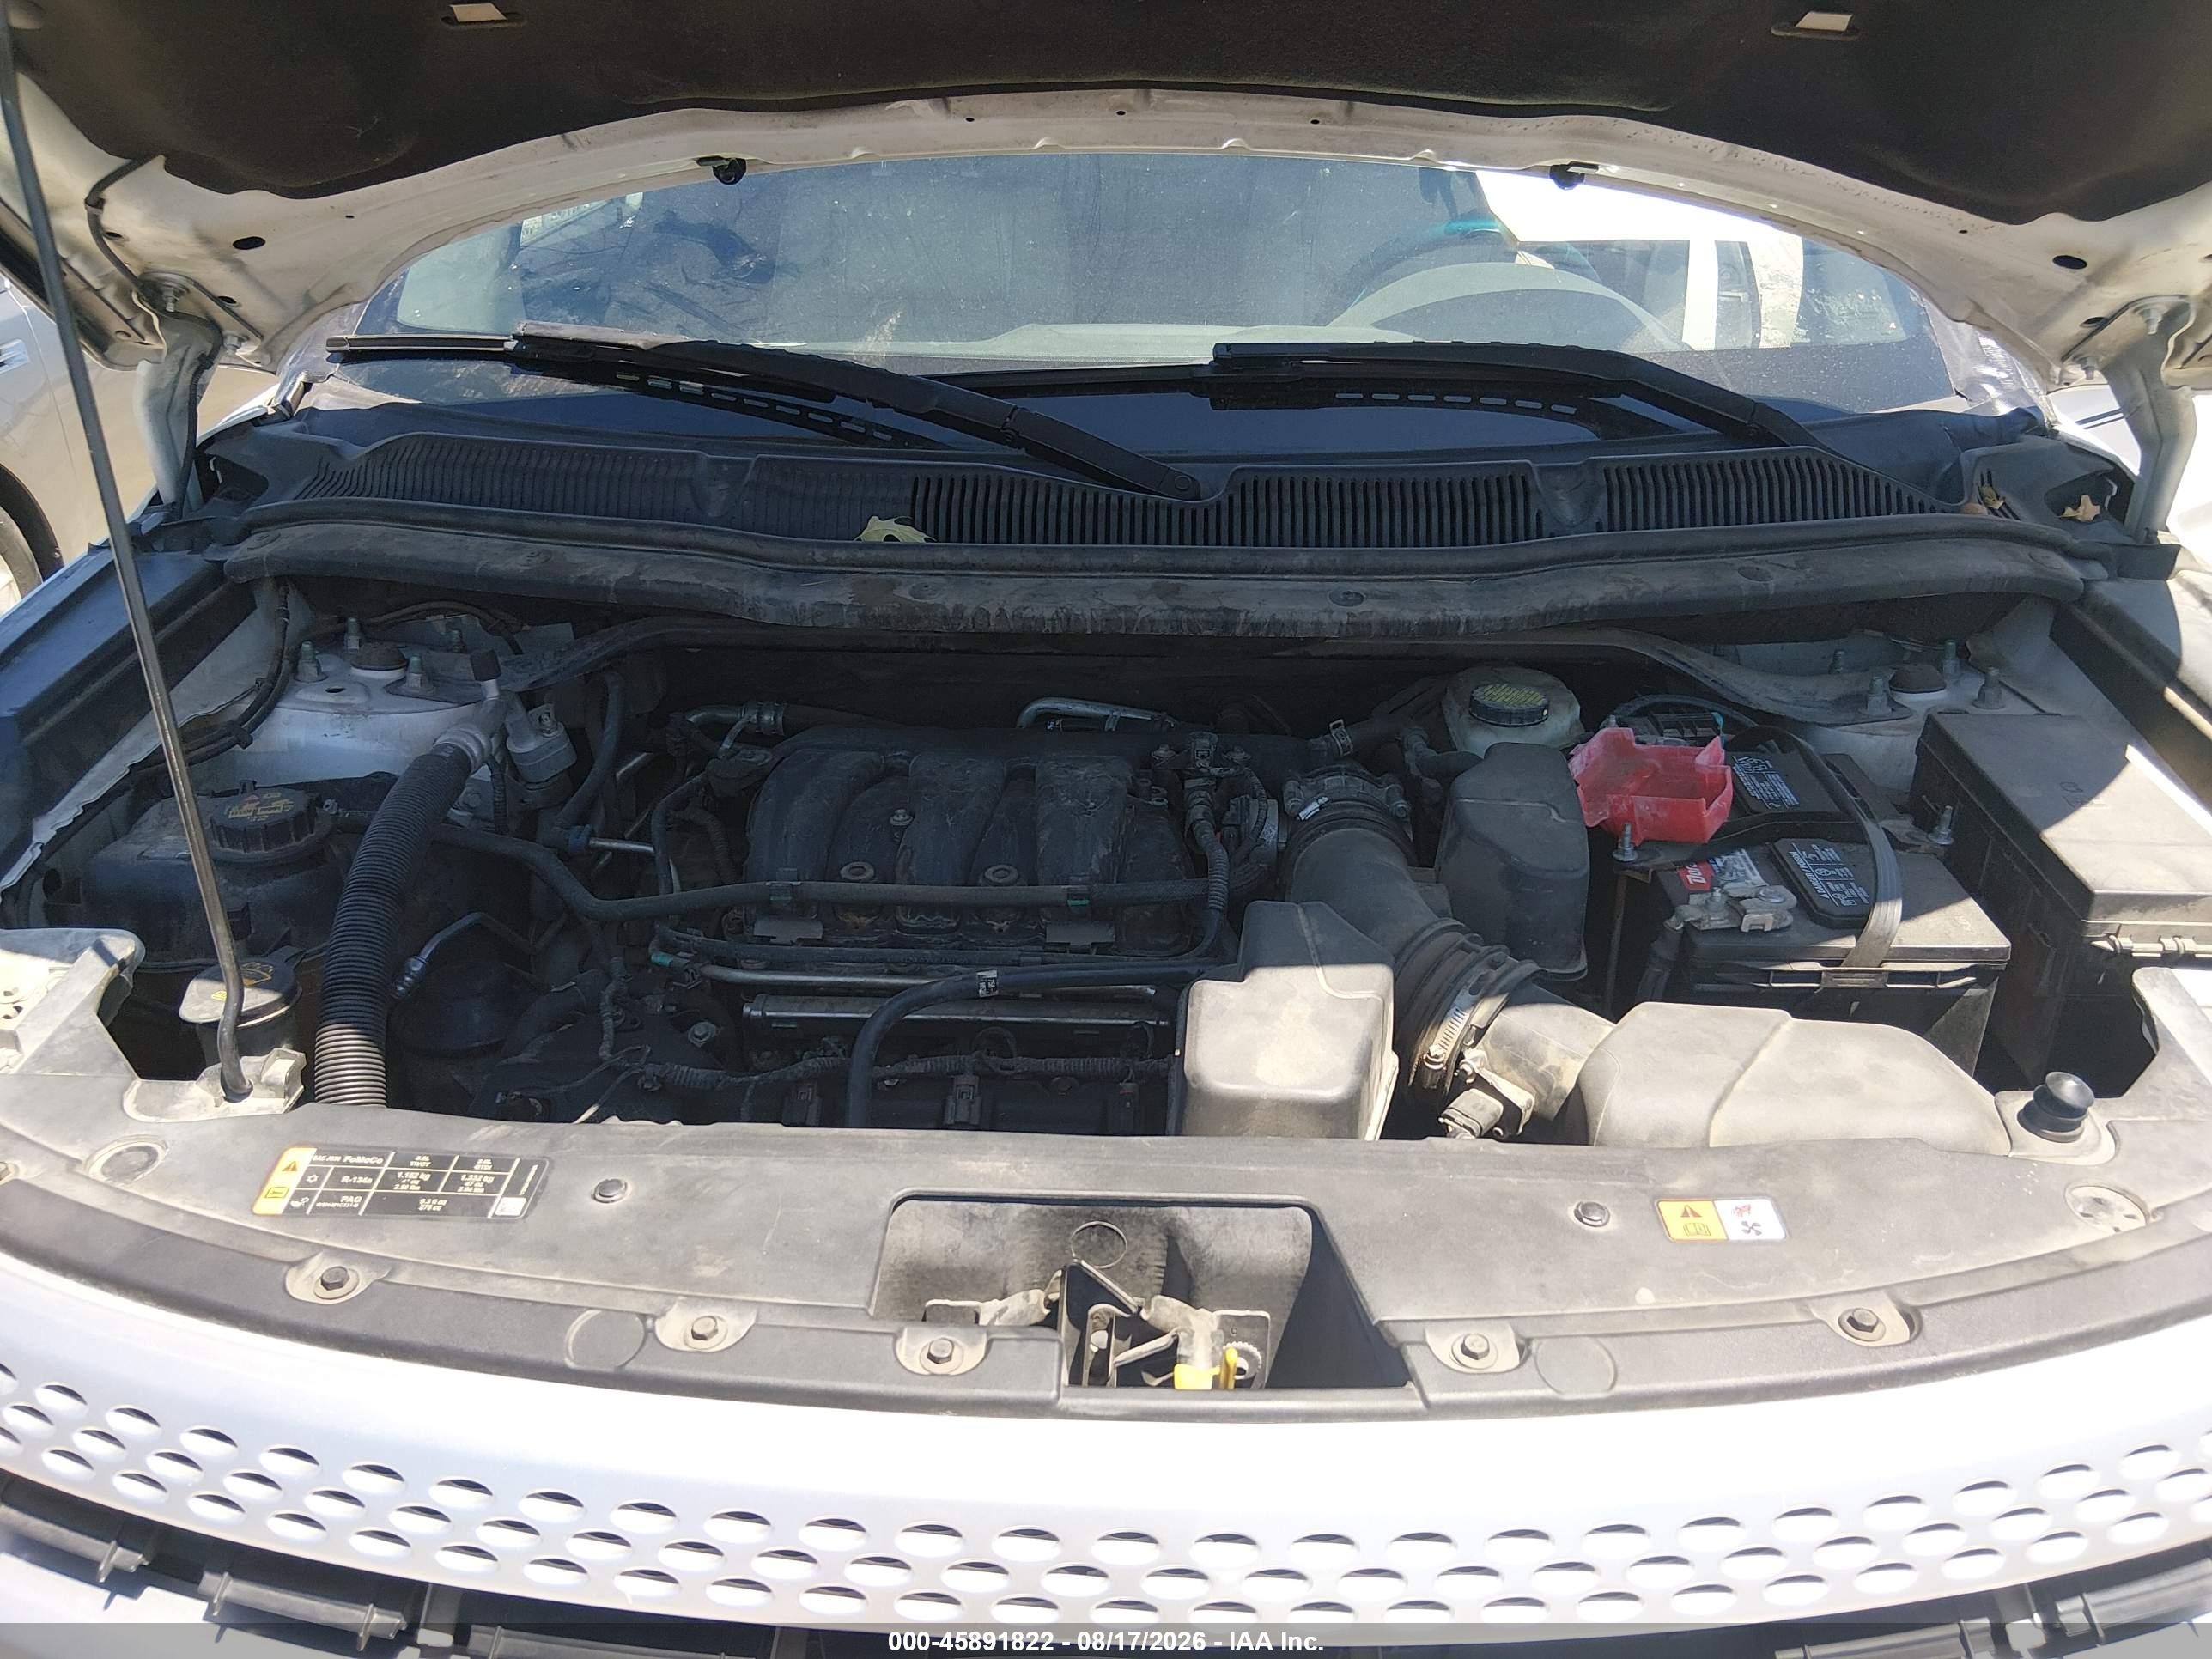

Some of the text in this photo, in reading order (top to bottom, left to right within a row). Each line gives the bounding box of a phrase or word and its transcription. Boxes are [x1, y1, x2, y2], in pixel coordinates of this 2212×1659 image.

[343, 1155, 384, 1164] FoMoCo
[340, 1176, 374, 1184] R-134a
[419, 1172, 431, 1182] kg
[483, 1175, 495, 1184] kg
